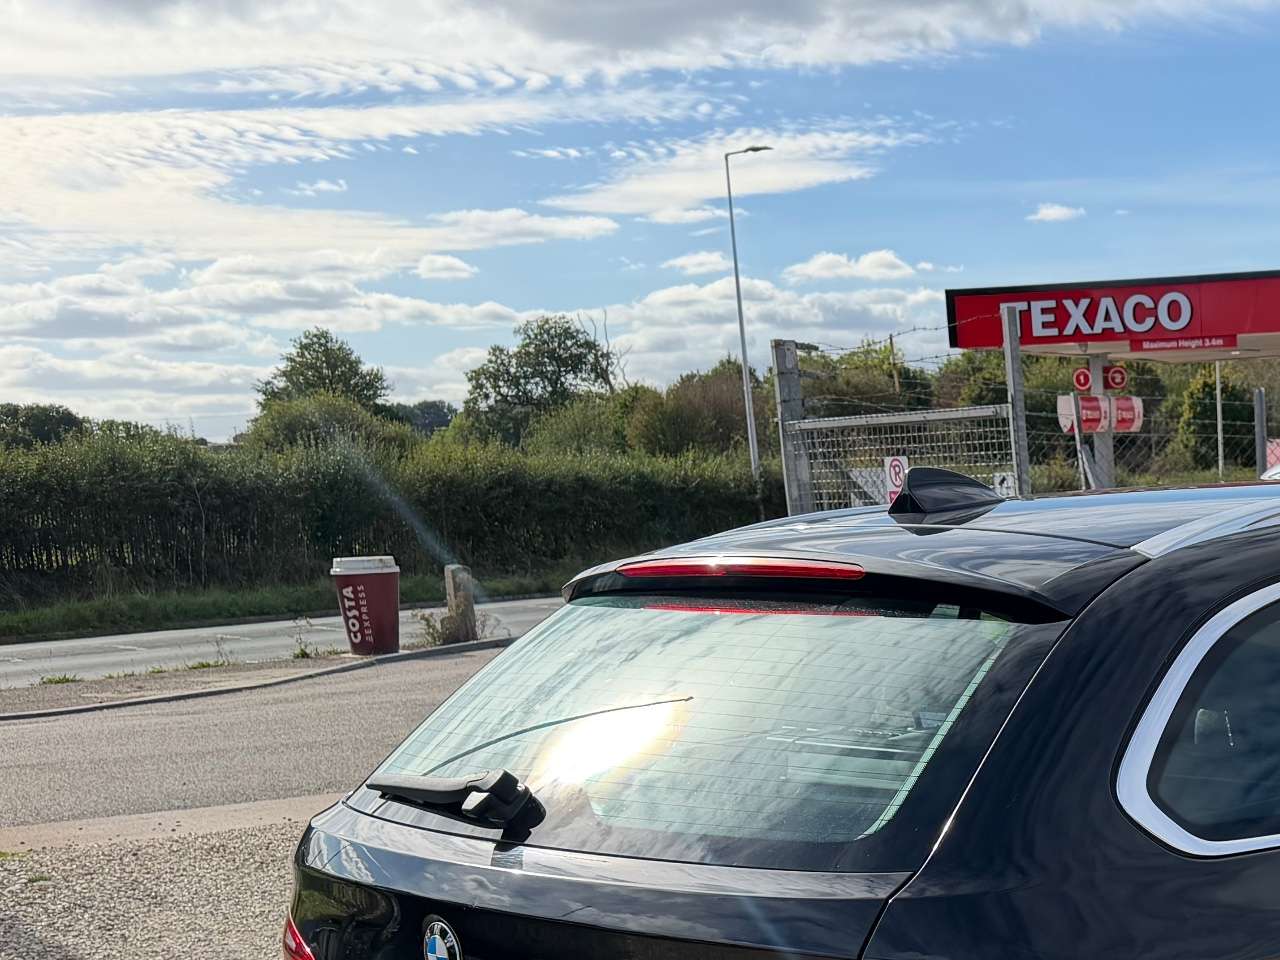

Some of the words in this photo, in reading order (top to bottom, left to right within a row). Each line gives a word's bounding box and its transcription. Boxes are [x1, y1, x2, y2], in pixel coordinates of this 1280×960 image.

[1000, 291, 1193, 337] TEXACO
[1142, 340, 1177, 349] Maximum
[1178, 338, 1202, 349] Height
[342, 586, 362, 644] COSTA
[357, 584, 373, 635] EXPRESS
